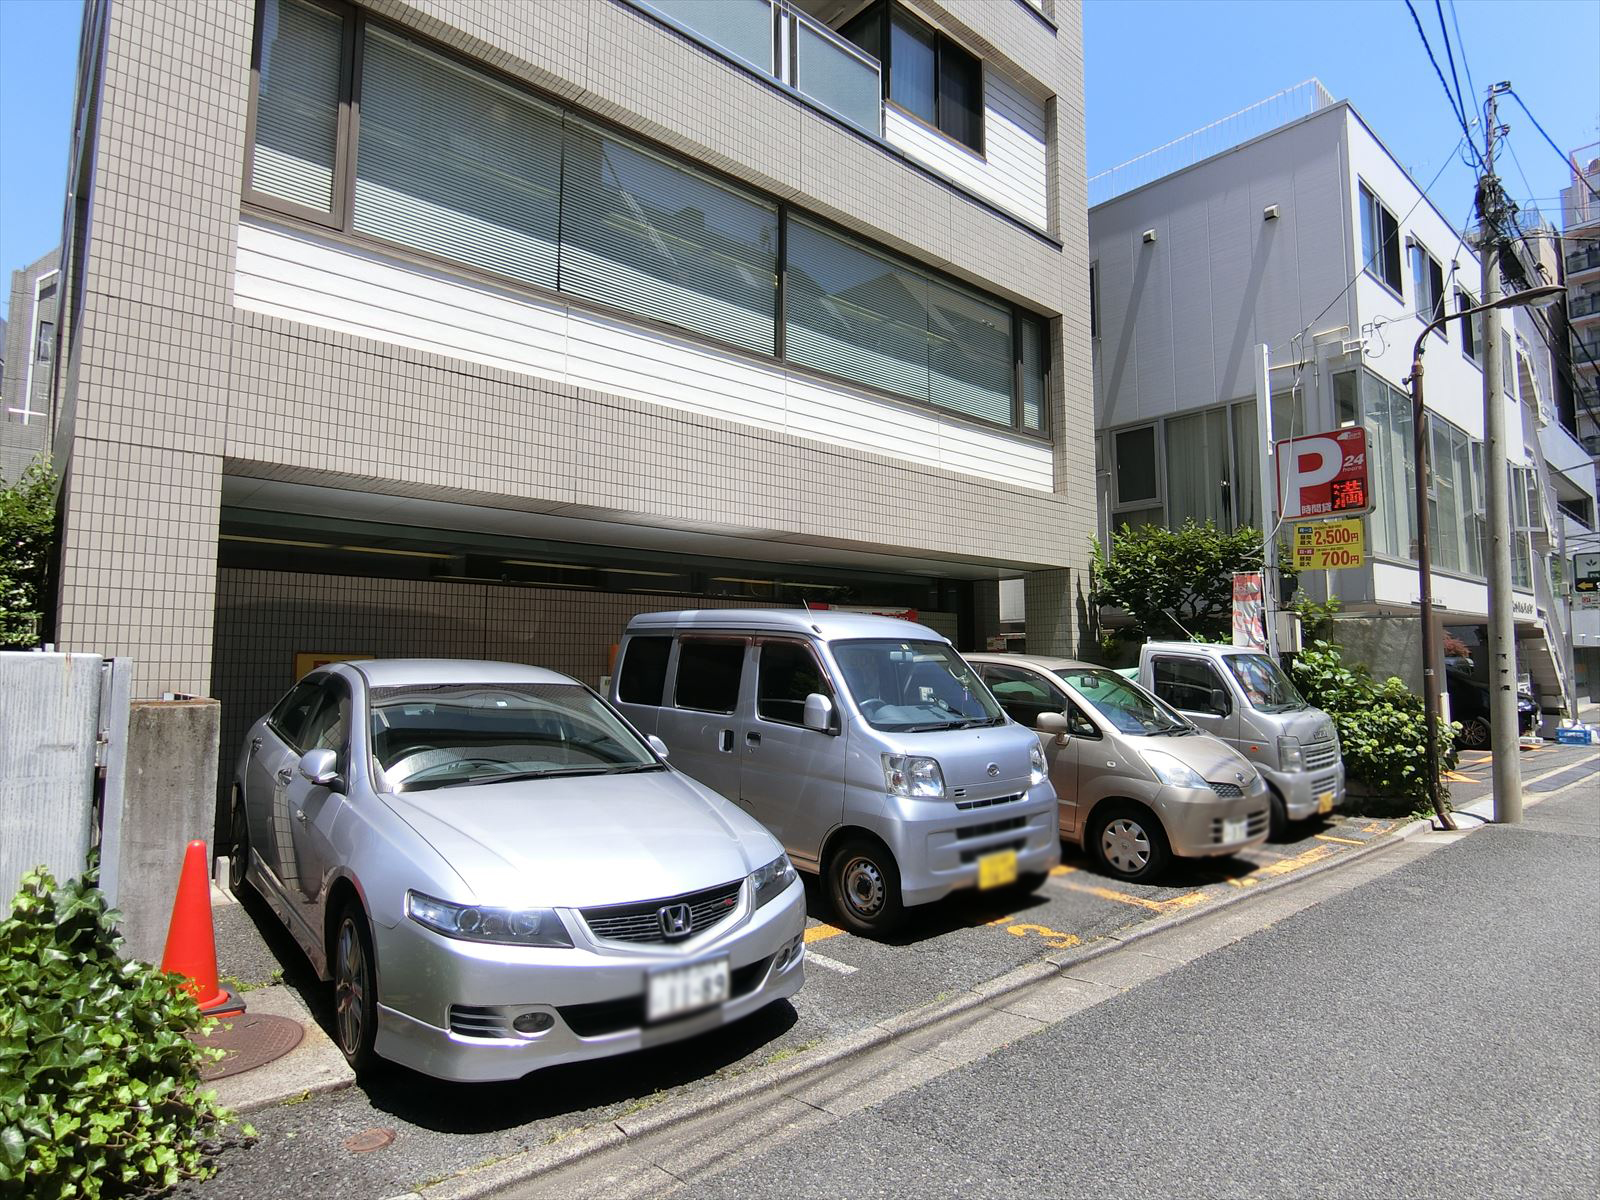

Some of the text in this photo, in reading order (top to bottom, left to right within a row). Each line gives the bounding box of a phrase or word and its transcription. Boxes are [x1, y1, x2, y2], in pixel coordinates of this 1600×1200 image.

[1343, 454, 1364, 466] 24
[1278, 437, 1343, 517] P
[1333, 480, 1364, 508] 満
[1301, 502, 1331, 515] 時間貸
[1314, 528, 1359, 545] 2,500円
[1321, 550, 1359, 566] 700円
[1007, 924, 1080, 949] 3
